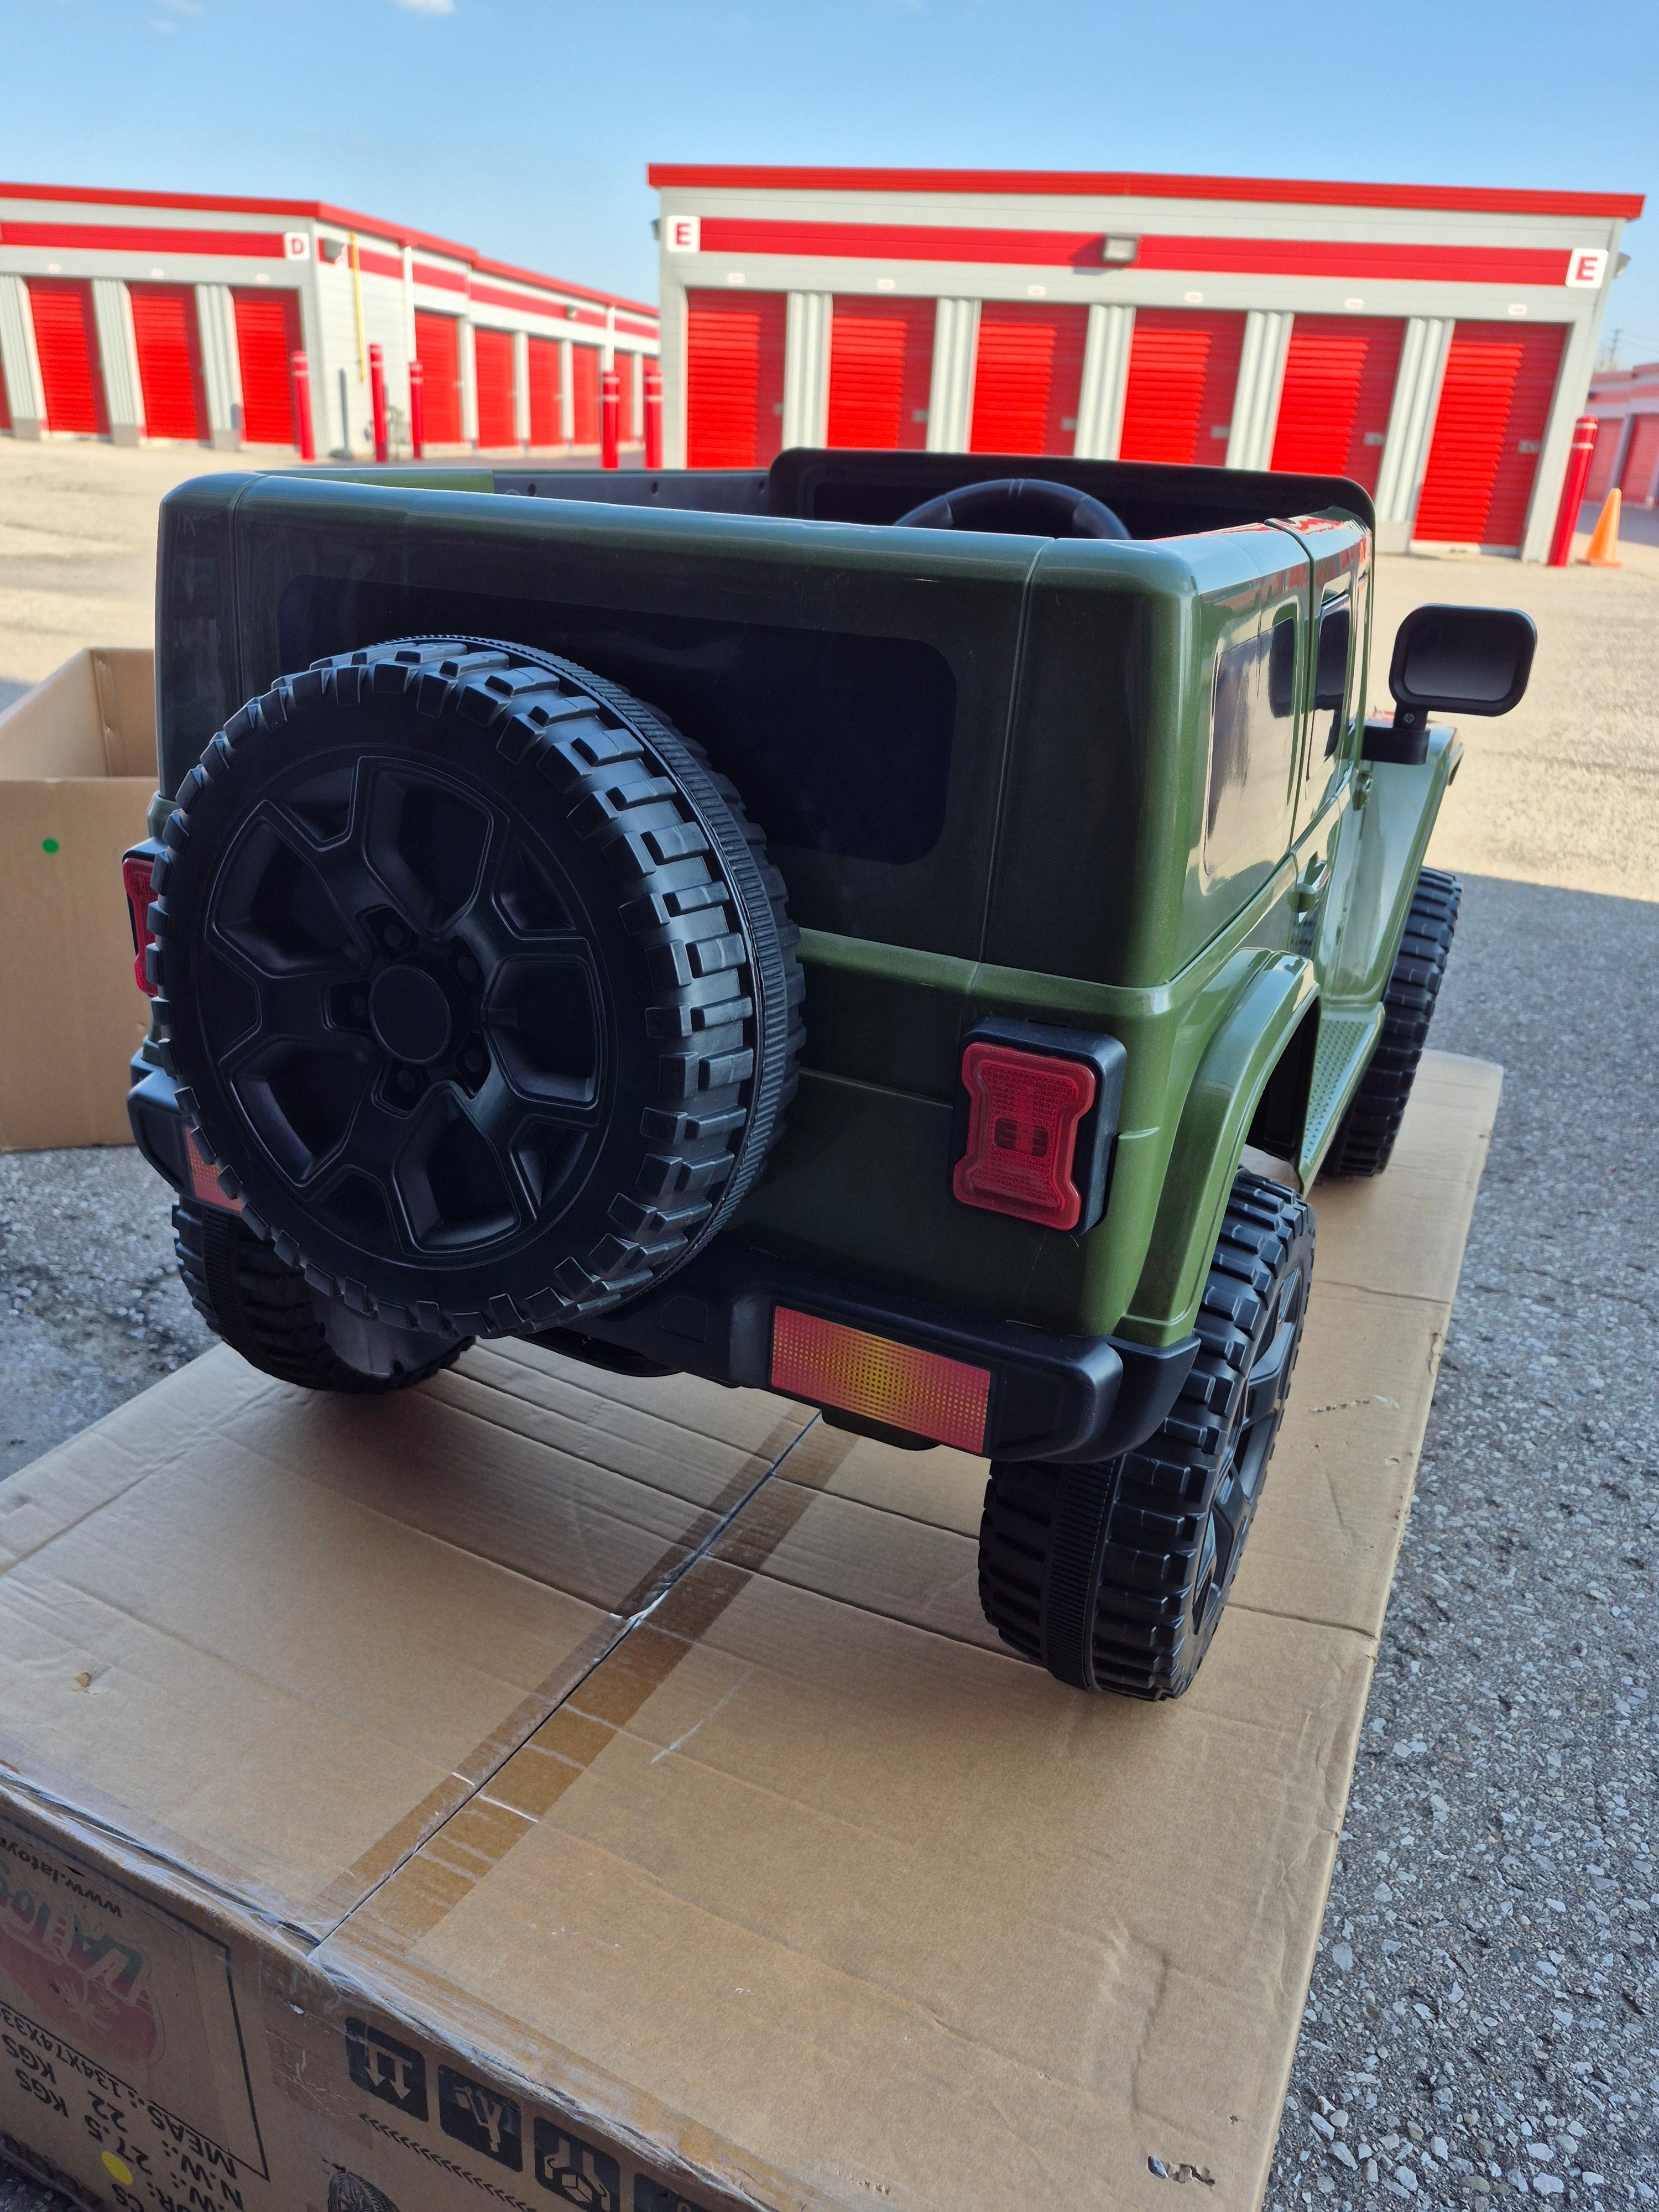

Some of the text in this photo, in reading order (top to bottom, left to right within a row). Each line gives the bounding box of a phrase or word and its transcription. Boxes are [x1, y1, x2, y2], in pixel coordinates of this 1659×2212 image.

[292, 238, 304, 254] D
[676, 222, 691, 245] E
[1576, 257, 1598, 280] E
[1, 2034, 56, 2085] KGS
[15, 2068, 69, 2119] KGS
[87, 2090, 128, 2133] 22
[84, 2115, 153, 2176] 27.5
